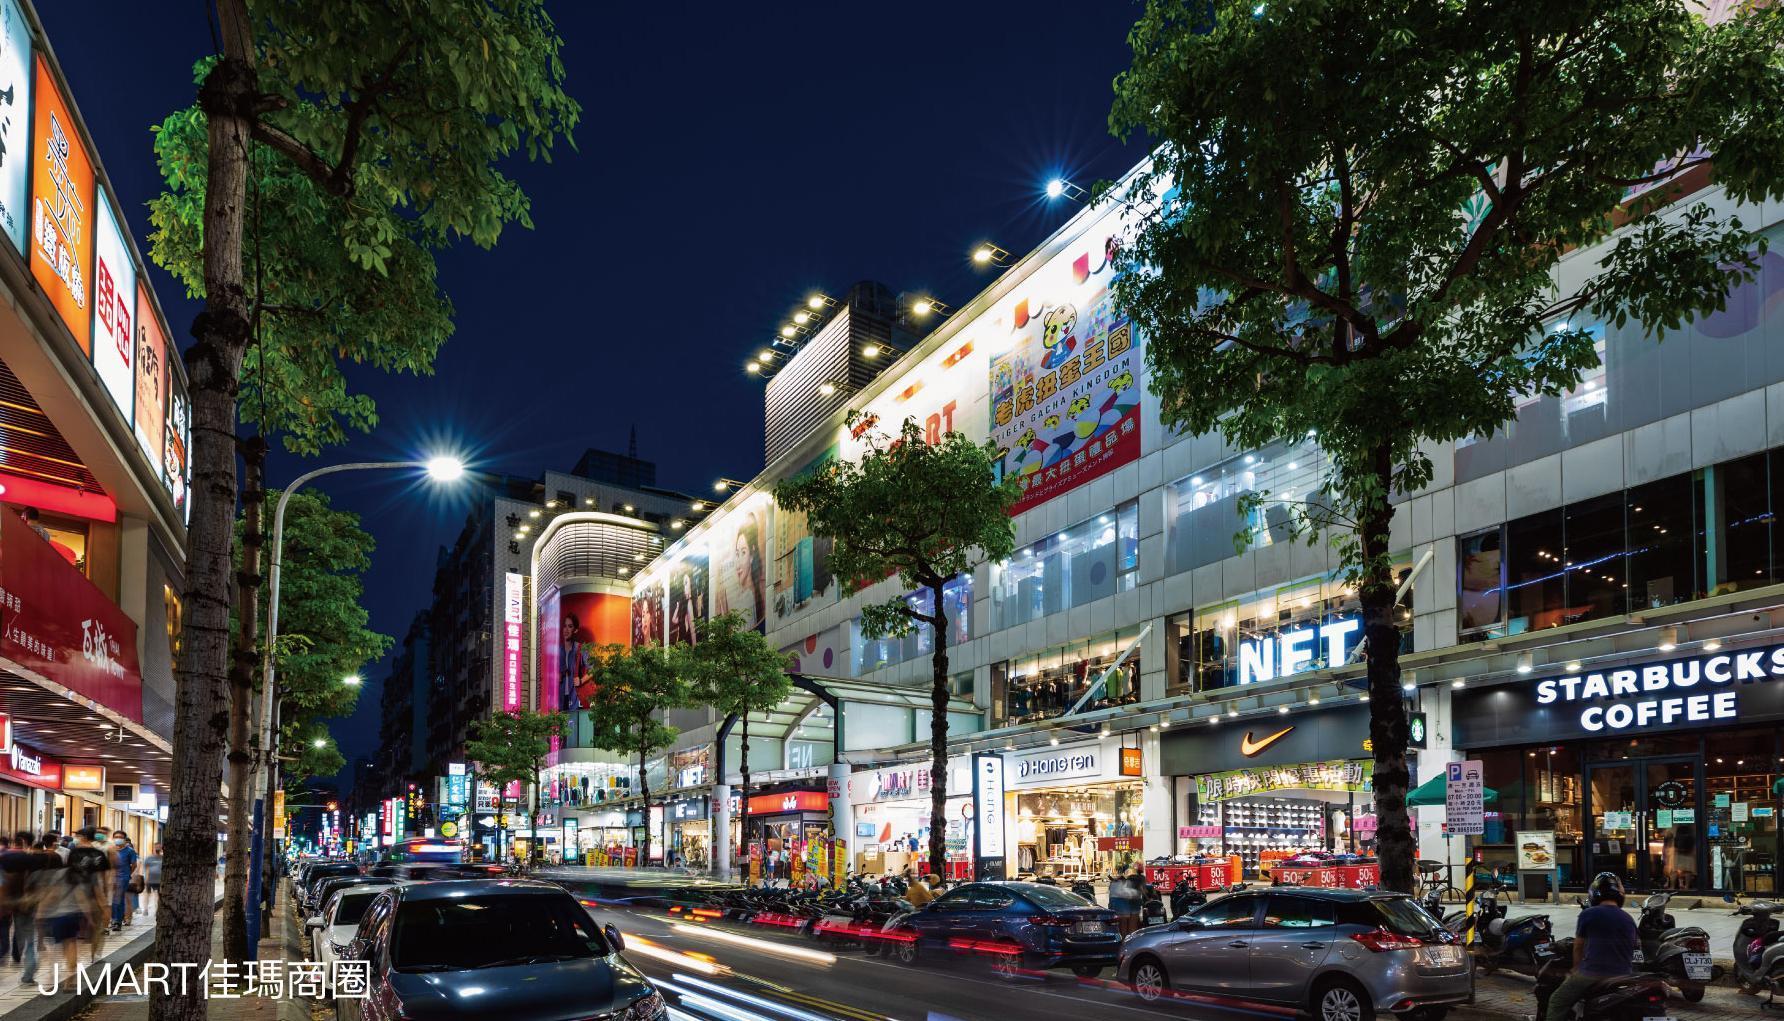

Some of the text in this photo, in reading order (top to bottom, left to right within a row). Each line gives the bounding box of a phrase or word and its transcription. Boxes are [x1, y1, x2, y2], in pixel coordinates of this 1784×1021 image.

[995, 322, 1131, 426] 老虎扭蛋王國
[995, 358, 1130, 442] TIGER GACHA KINGDOM
[1240, 619, 1359, 685] NET
[1580, 692, 1737, 731] COFFEE
[1206, 763, 1364, 800] 限時快閃優惠活動
[1451, 765, 1460, 780] P
[1210, 867, 1224, 878] 50%
[1211, 878, 1224, 887] SALE
[1321, 870, 1336, 884] 50%
[1359, 868, 1374, 880] 50%
